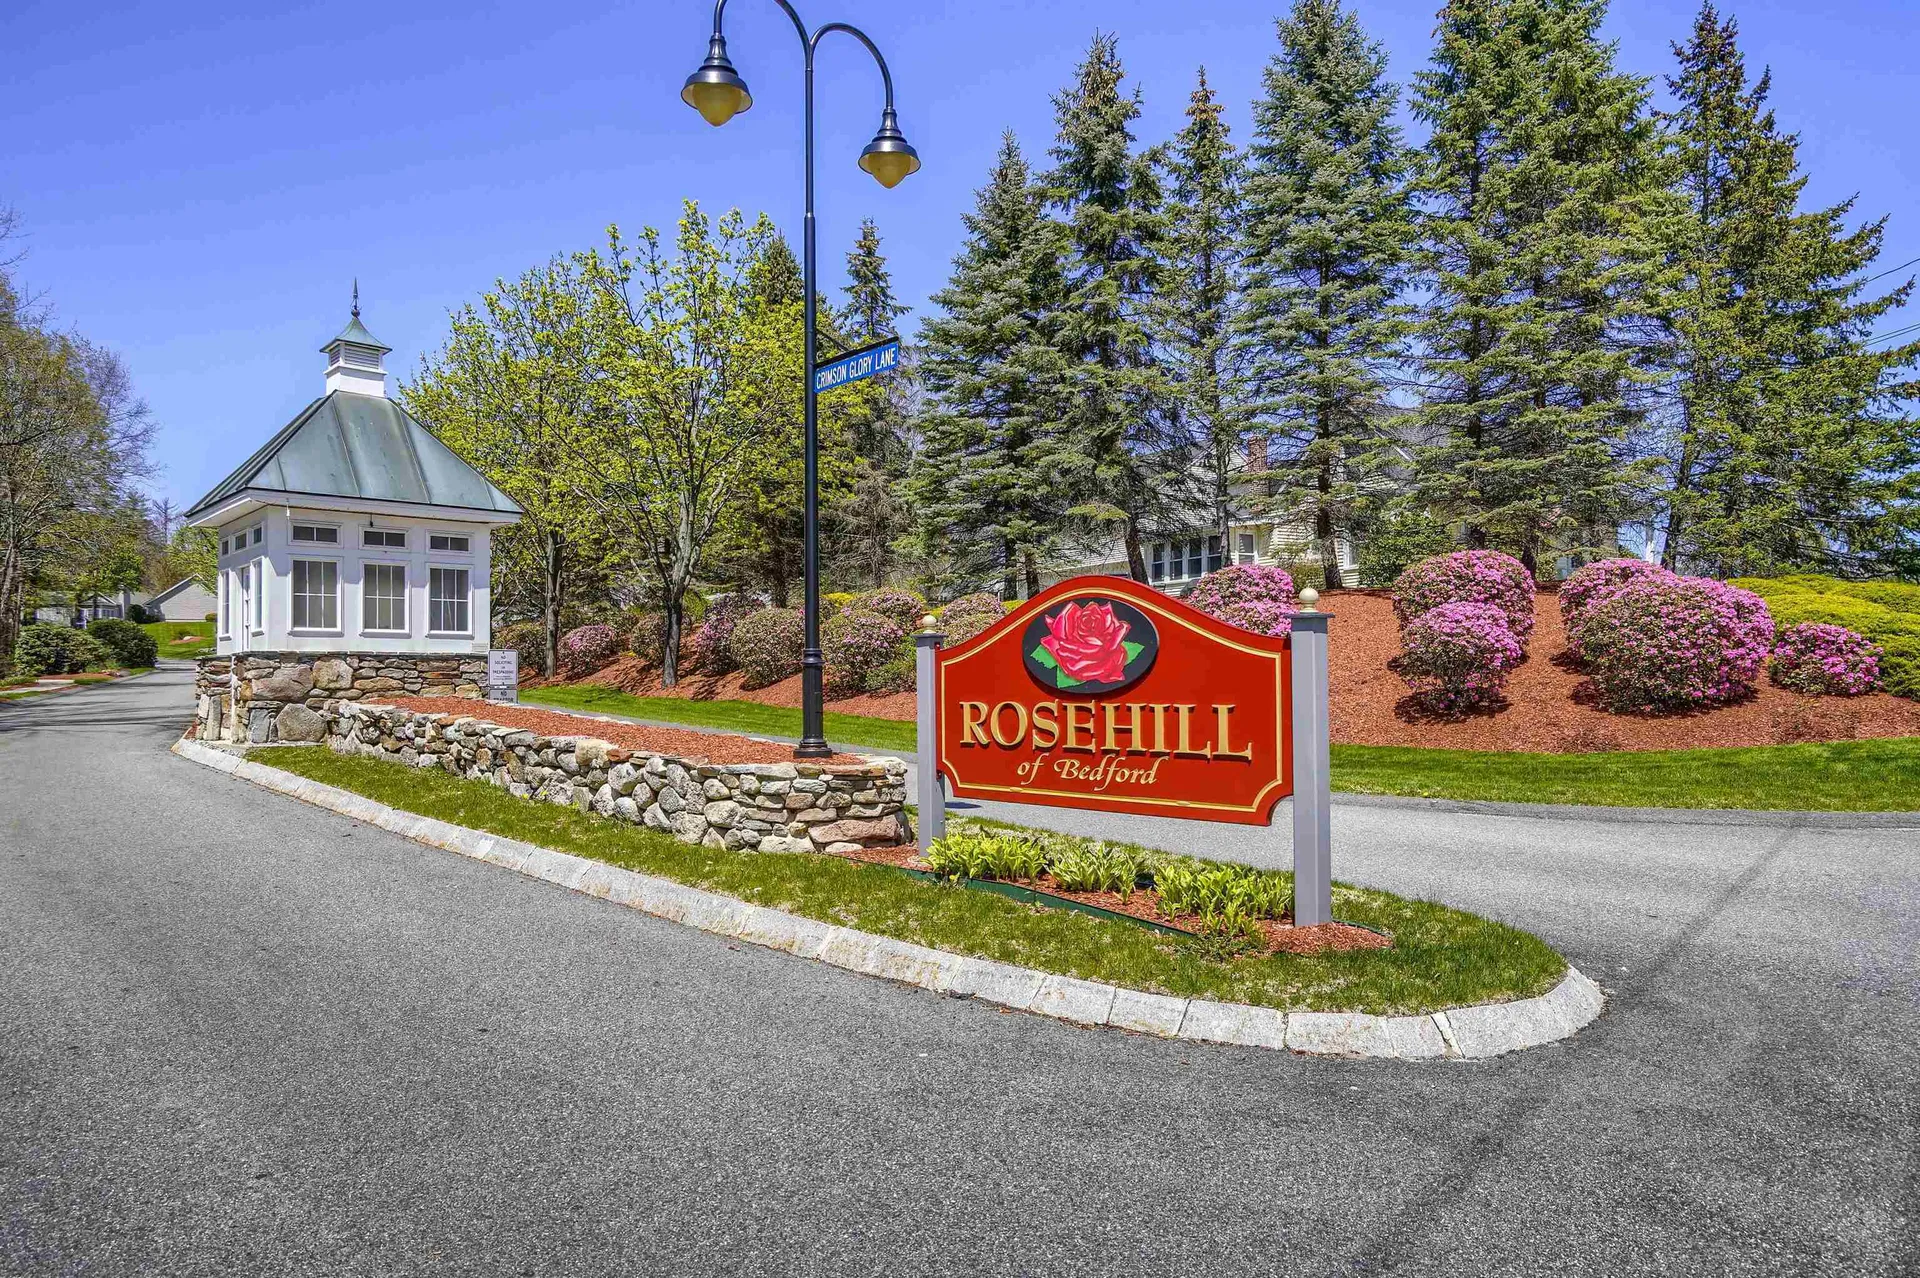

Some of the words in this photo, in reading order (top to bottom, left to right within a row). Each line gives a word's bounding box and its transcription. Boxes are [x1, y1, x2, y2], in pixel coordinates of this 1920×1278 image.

[816, 364, 847, 389] CRIMSON
[849, 355, 873, 378] GLORY
[875, 347, 896, 370] LANE
[959, 699, 1253, 760] ROSEHILL
[1017, 752, 1050, 785] of
[1054, 753, 1169, 791] Bedford
